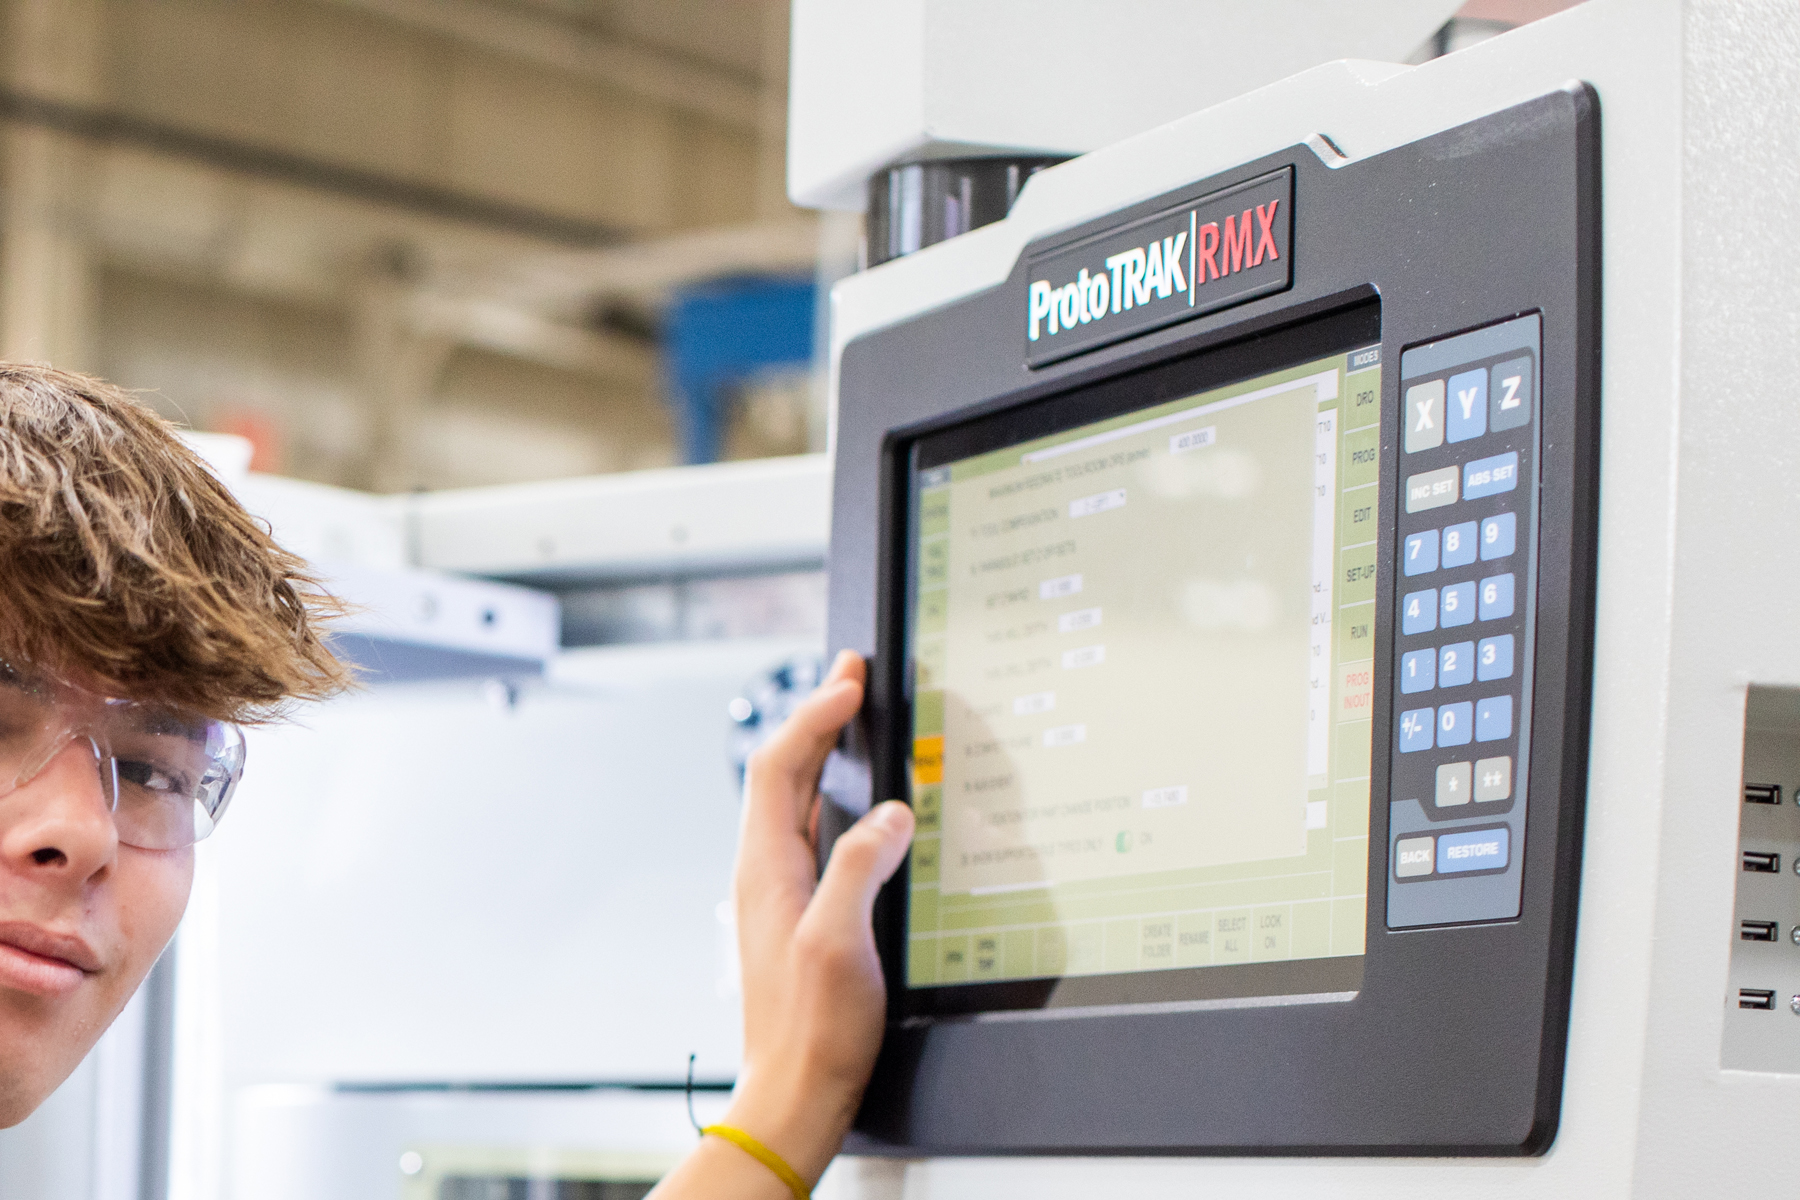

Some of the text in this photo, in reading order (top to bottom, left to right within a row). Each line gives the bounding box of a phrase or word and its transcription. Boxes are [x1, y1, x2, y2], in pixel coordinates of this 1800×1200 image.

[1027, 199, 1280, 341] ProtoTRAK RMX
[1353, 350, 1379, 368] MODES
[1356, 390, 1374, 407] DRO
[1414, 375, 1522, 432] X Y Z
[1352, 448, 1376, 466] PROG
[1467, 464, 1515, 487] ABS SET
[1410, 478, 1453, 500] INC SET
[1353, 507, 1371, 523] EDIT
[1409, 522, 1499, 560] 7 8 9
[1346, 564, 1376, 582] SET-UP
[1407, 583, 1497, 618] 4 5 6
[1350, 624, 1368, 640] RUN
[1407, 644, 1496, 678] 1 2 3
[1346, 671, 1369, 688] PROG
[1343, 693, 1370, 710] IN/OUT
[1442, 710, 1456, 731] 0
[1399, 841, 1499, 865] BACK RESTORE
[1218, 916, 1247, 932] SELECT
[1260, 914, 1282, 929] LOOK
